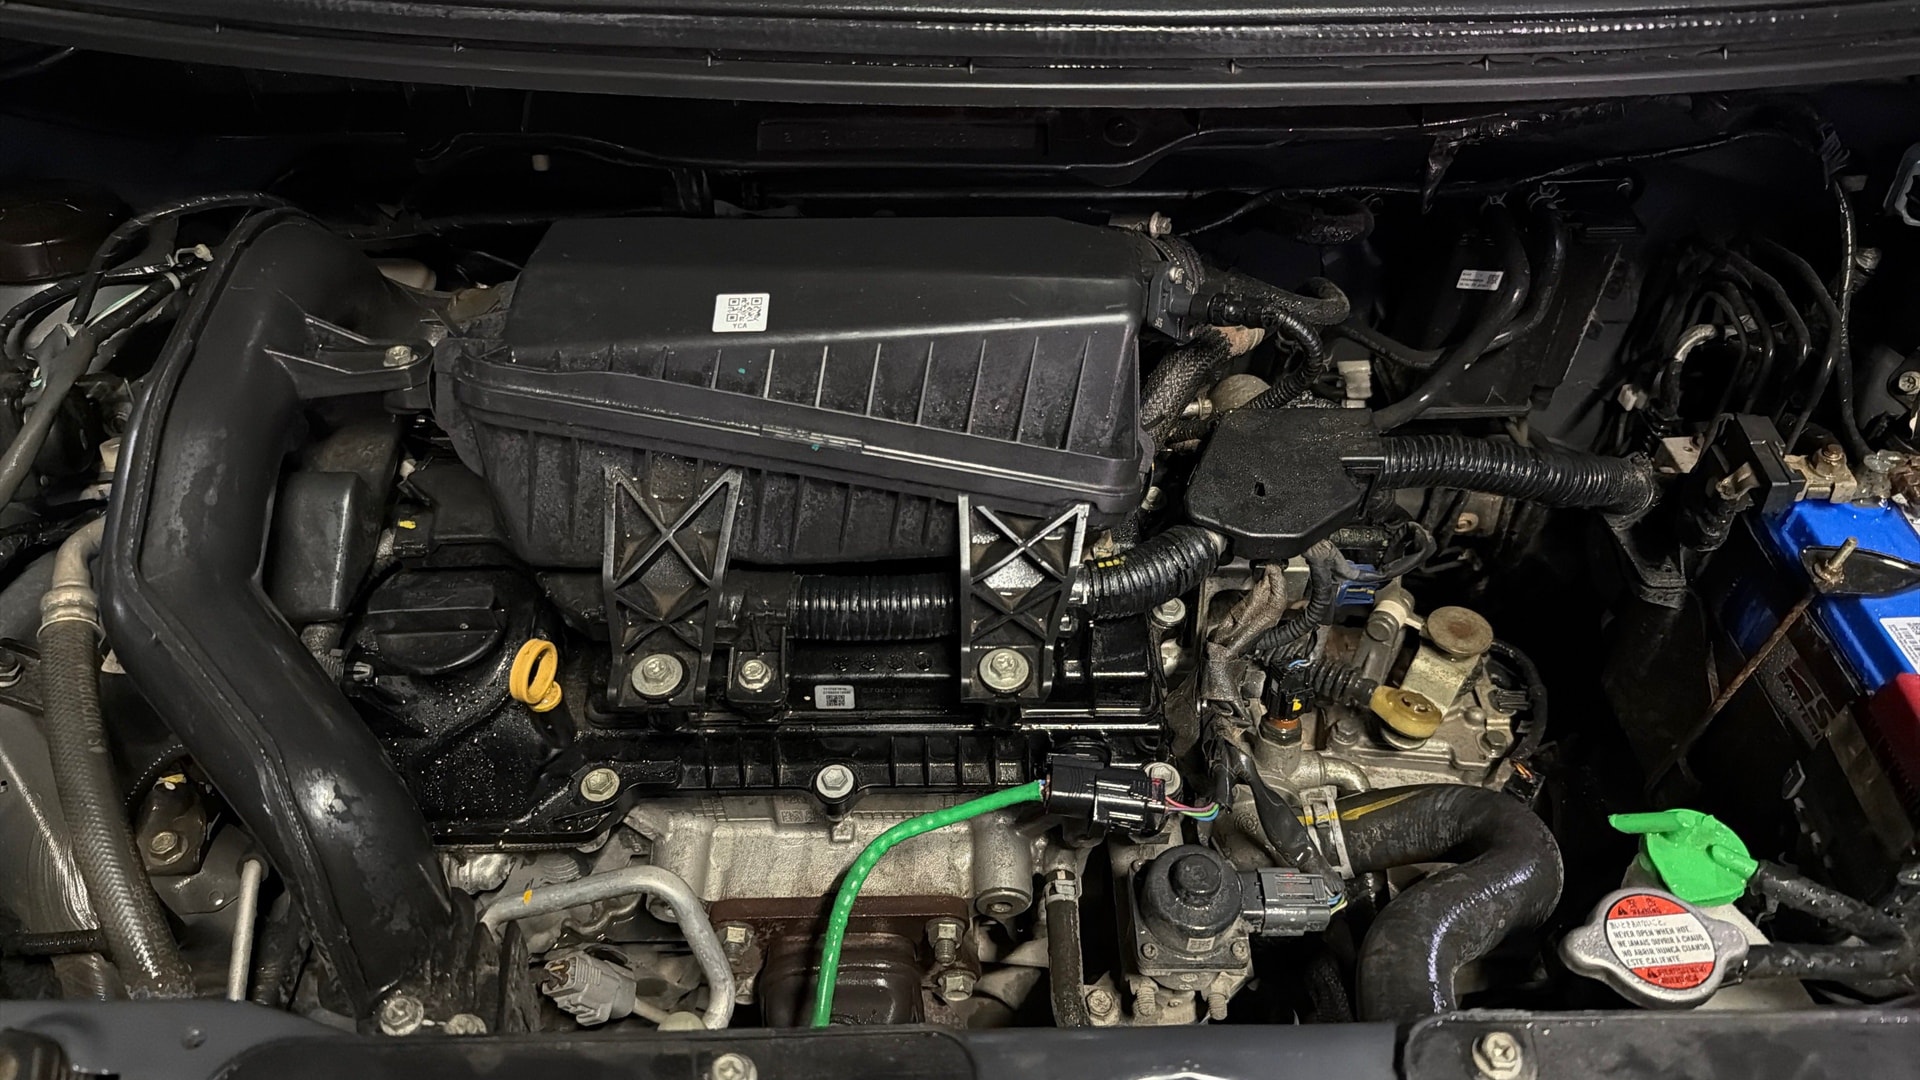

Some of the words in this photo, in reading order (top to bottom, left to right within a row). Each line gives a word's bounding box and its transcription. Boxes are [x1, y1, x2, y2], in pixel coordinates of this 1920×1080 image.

[1613, 930, 1634, 938] NEVER
[1655, 927, 1675, 935] WHEN
[1622, 949, 1632, 957] NO
